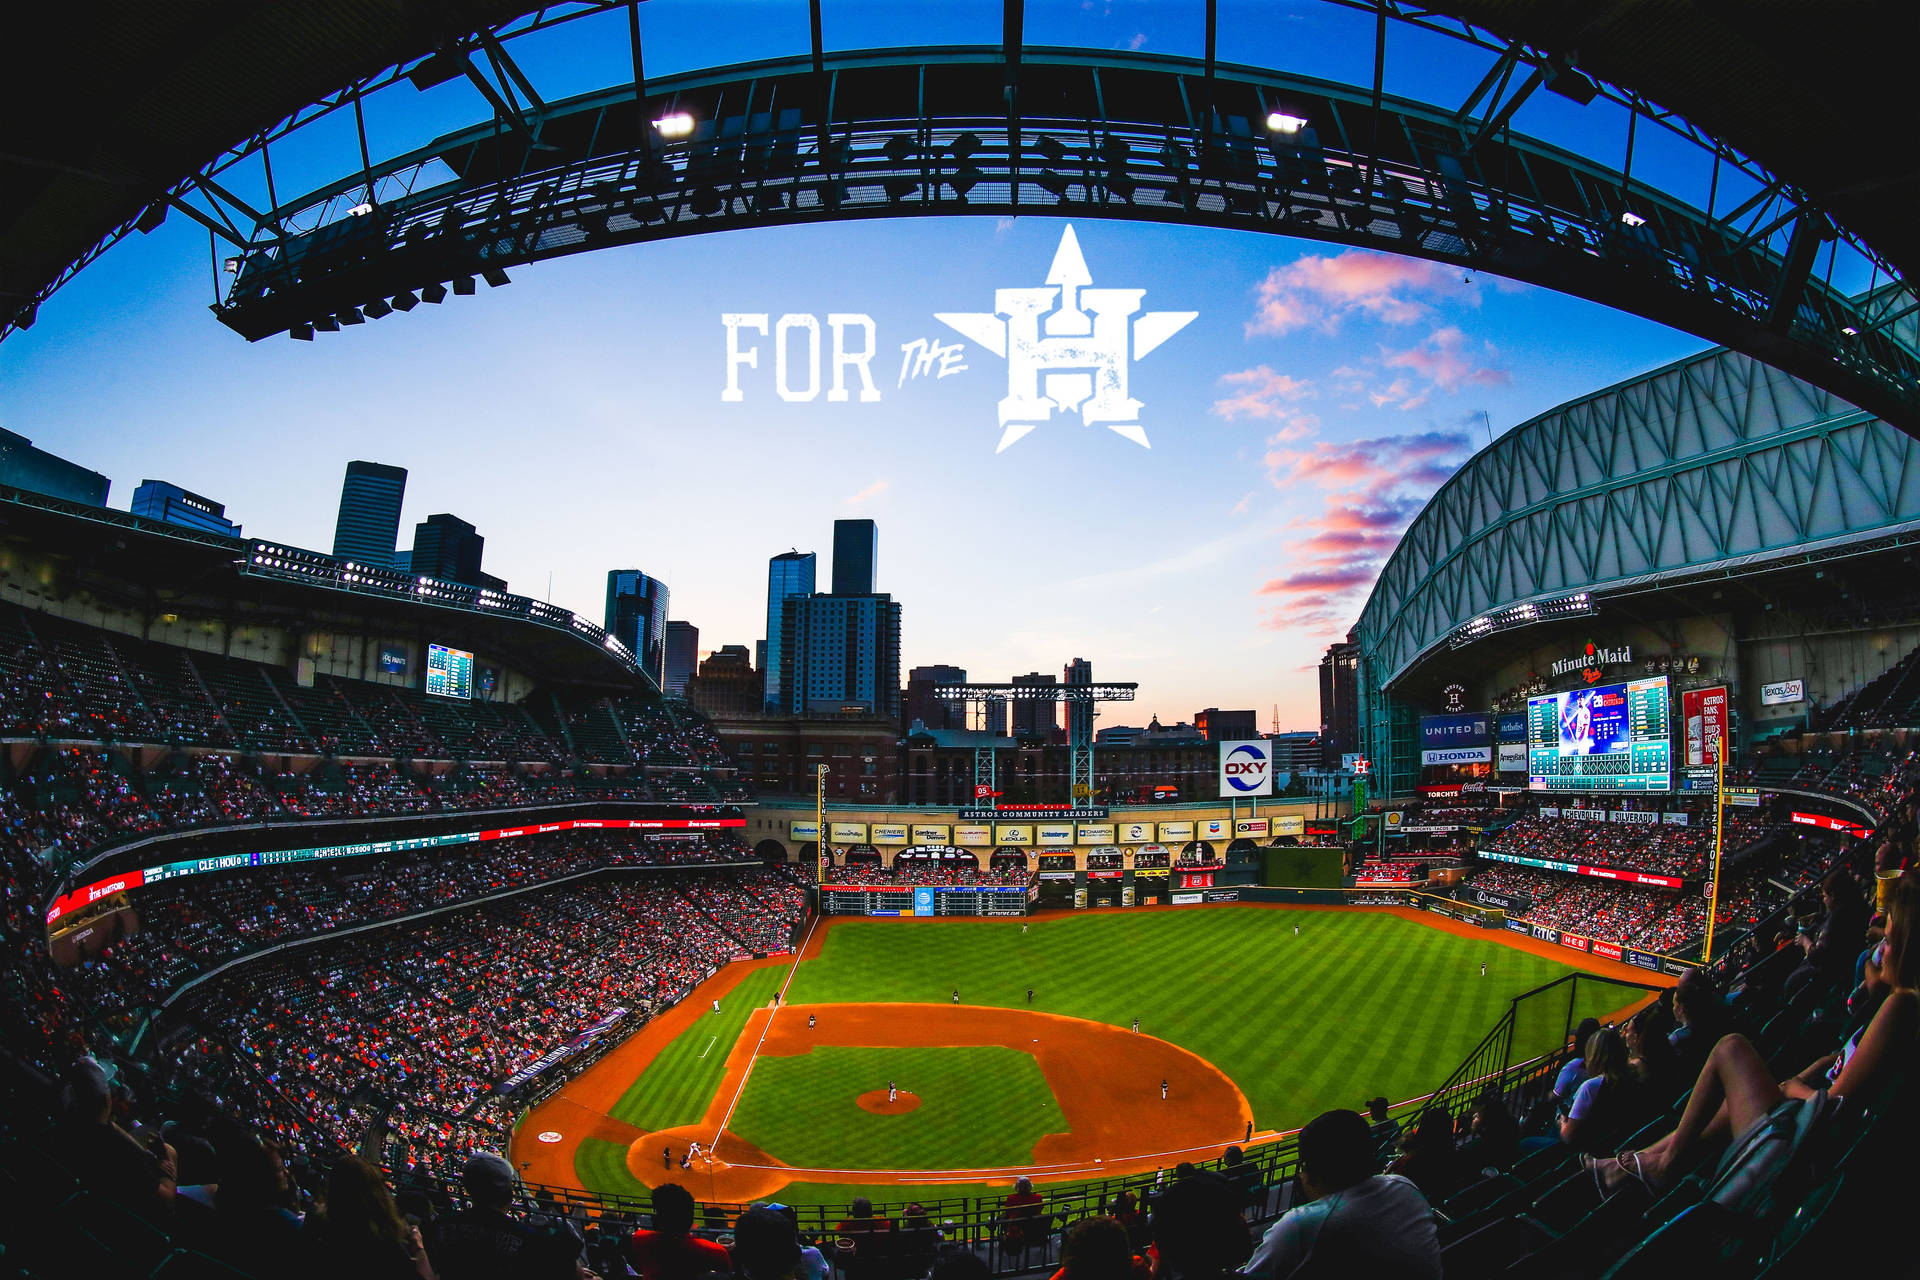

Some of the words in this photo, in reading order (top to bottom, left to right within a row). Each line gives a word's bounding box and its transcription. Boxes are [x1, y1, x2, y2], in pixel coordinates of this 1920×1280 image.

[1551, 654, 1595, 677] Minute
[1596, 645, 1632, 664] Maid
[1785, 682, 1801, 696] Bay
[1449, 693, 1459, 704] H
[1703, 695, 1724, 706] ASTROS
[1704, 715, 1716, 724] THIS
[1425, 725, 1471, 736] UNITED
[1438, 751, 1485, 761] HONDA
[1225, 761, 1267, 775] OXY
[1354, 760, 1368, 774] H
[977, 787, 987, 795] 05
[1565, 810, 1601, 820] CHEVROLET
[1615, 812, 1653, 824] SILVERADO
[198, 860, 214, 871] CLE
[219, 856, 236, 868] HOU
[1486, 897, 1509, 907] LEXUS
[1533, 926, 1556, 941] RTIC
